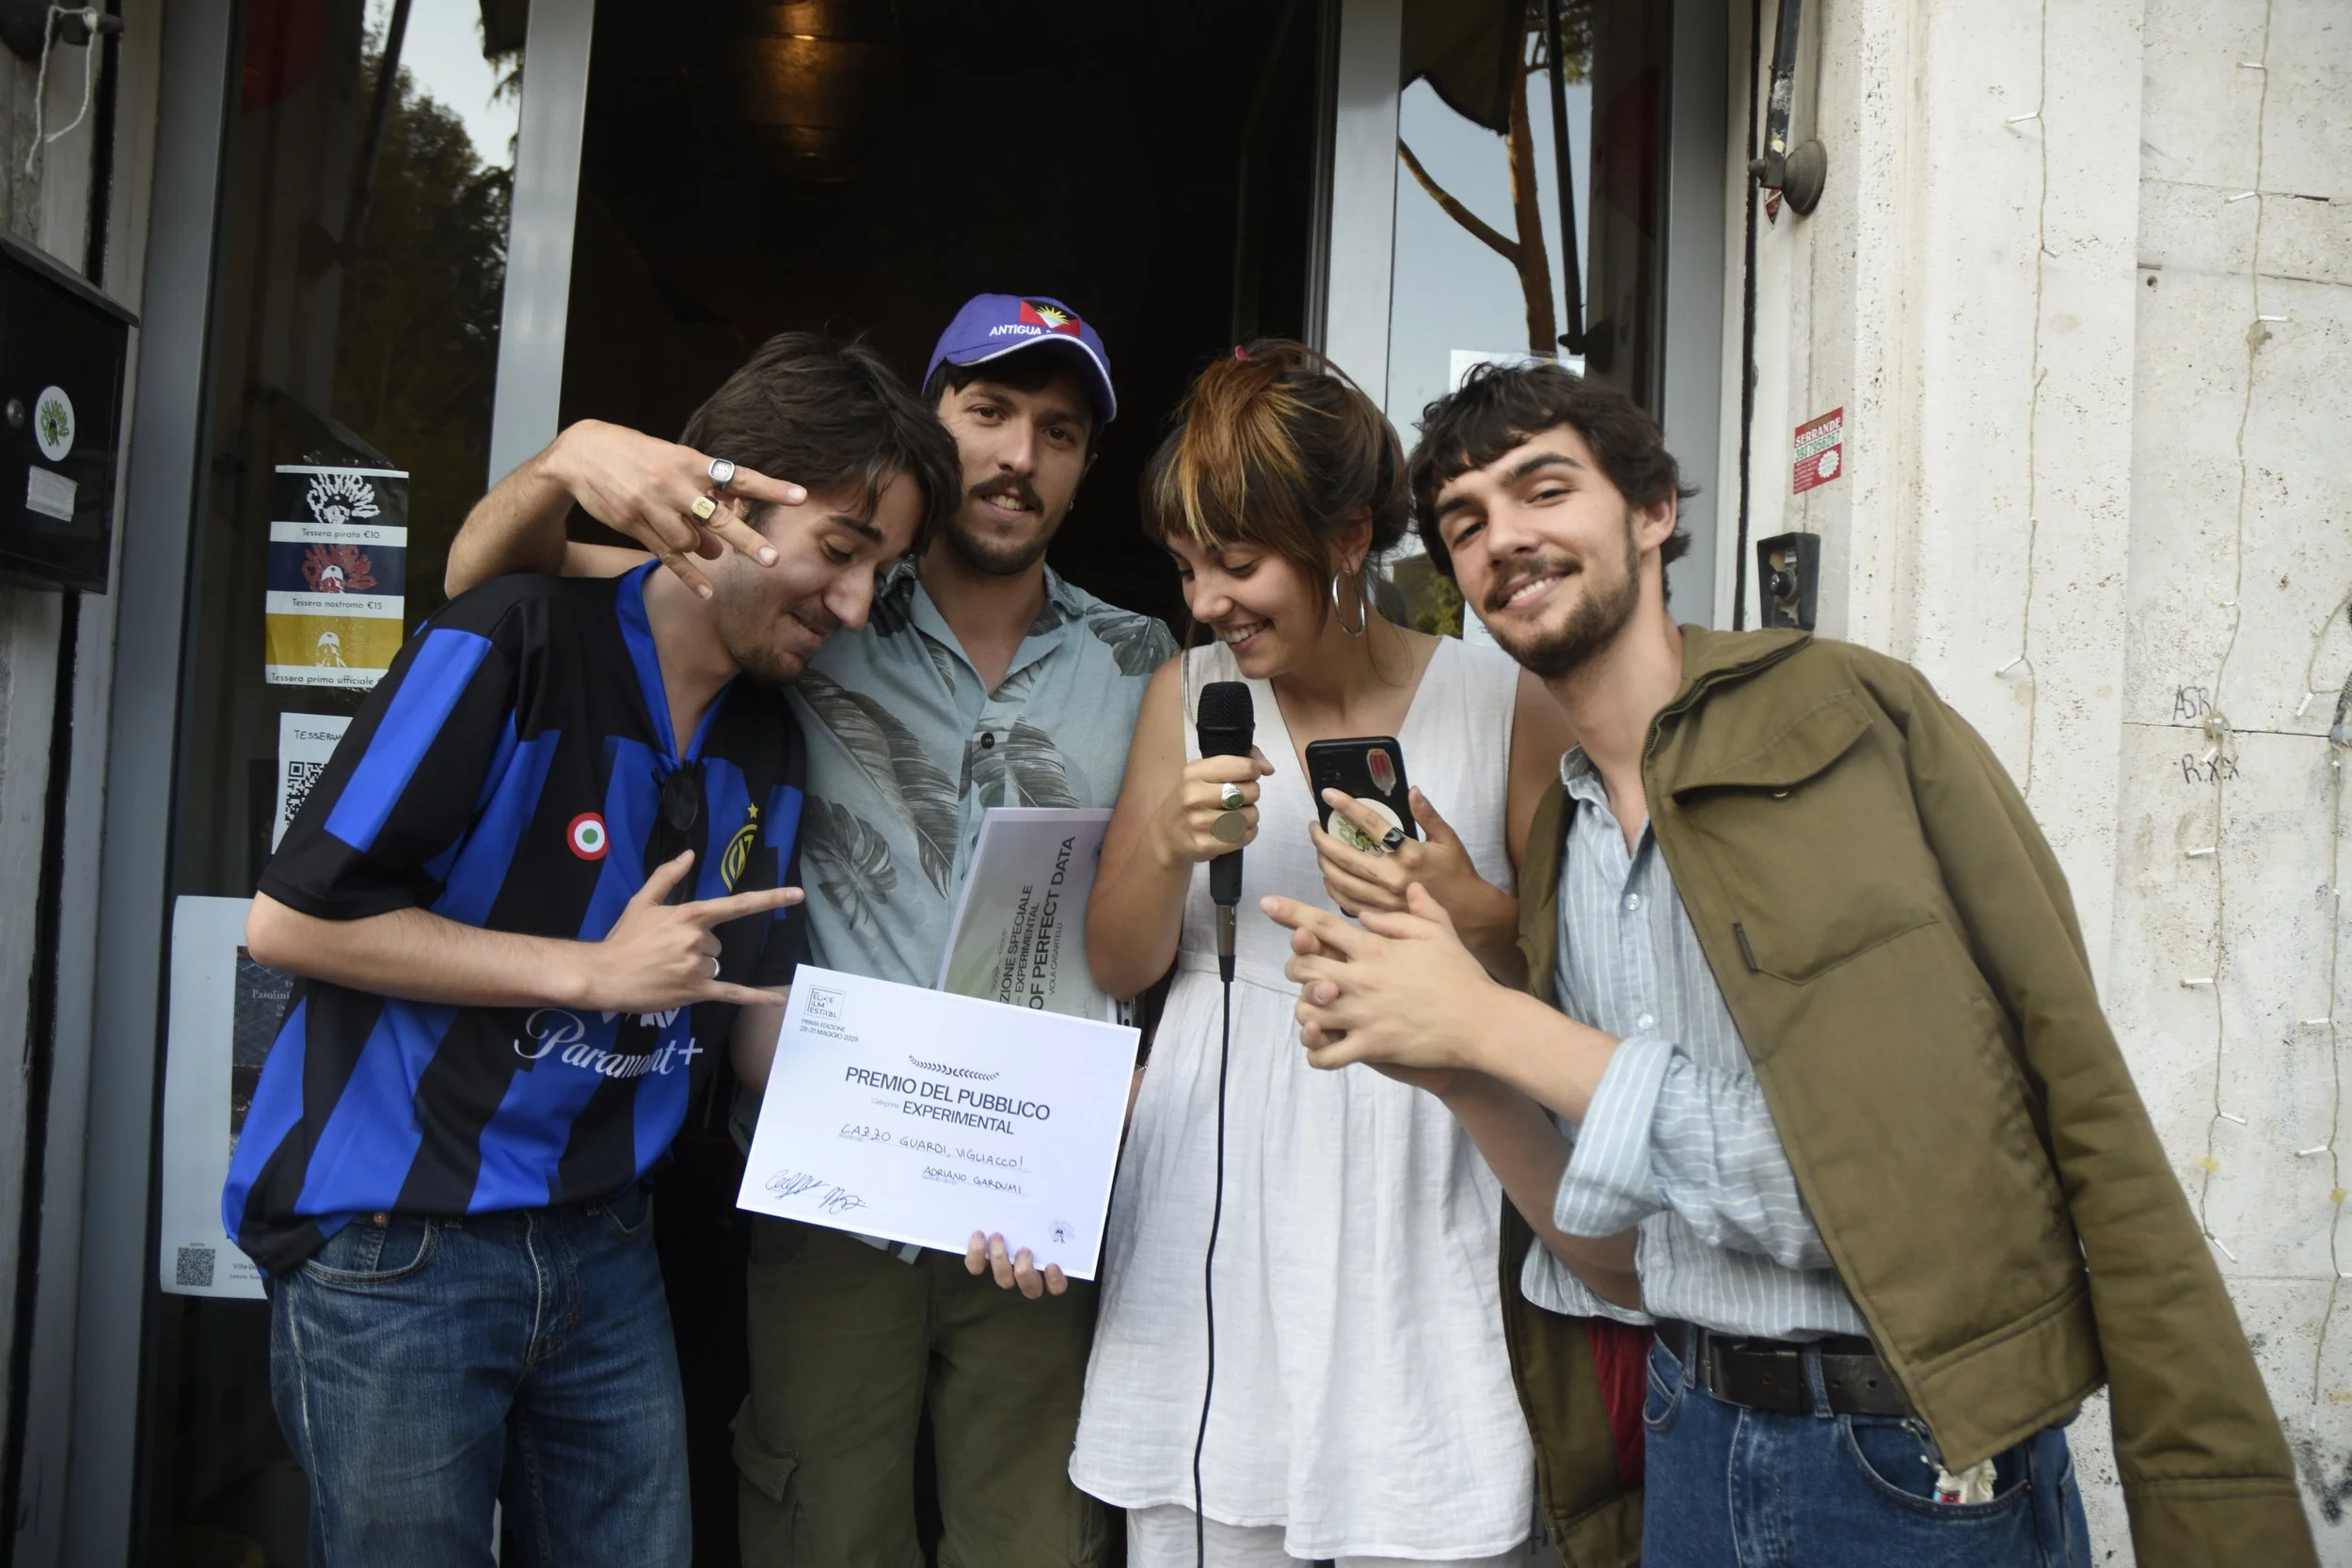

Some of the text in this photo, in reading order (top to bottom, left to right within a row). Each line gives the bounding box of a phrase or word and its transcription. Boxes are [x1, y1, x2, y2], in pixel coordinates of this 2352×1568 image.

[990, 325, 1041, 337] ANTIGUA
[1796, 417, 1841, 447] SERRANDE
[302, 528, 380, 539] Tessera pirata €10
[293, 597, 382, 610] Tessera nostromo €15
[271, 672, 374, 686] Tessera primo ufficiale
[1008, 884, 1033, 955] SPECIALE
[1029, 836, 1076, 1010] OF PERFECT DATA
[1015, 902, 1040, 993] EXPERIMENTAL
[1051, 922, 1063, 970] CASARTELLI
[252, 988, 290, 1000] Pasolini
[802, 1018, 846, 1033] PRIMA EDIZIONE
[816, 1029, 843, 1039] MAGGIO
[845, 1067, 1051, 1120] PREMIO DEL PUBBLICO
[902, 1101, 1014, 1134] EXPERIMENTAL
[840, 1124, 1024, 1170] CAZZO GUARDI, VIGLIACCO!
[923, 1166, 967, 1182] ADRIANO
